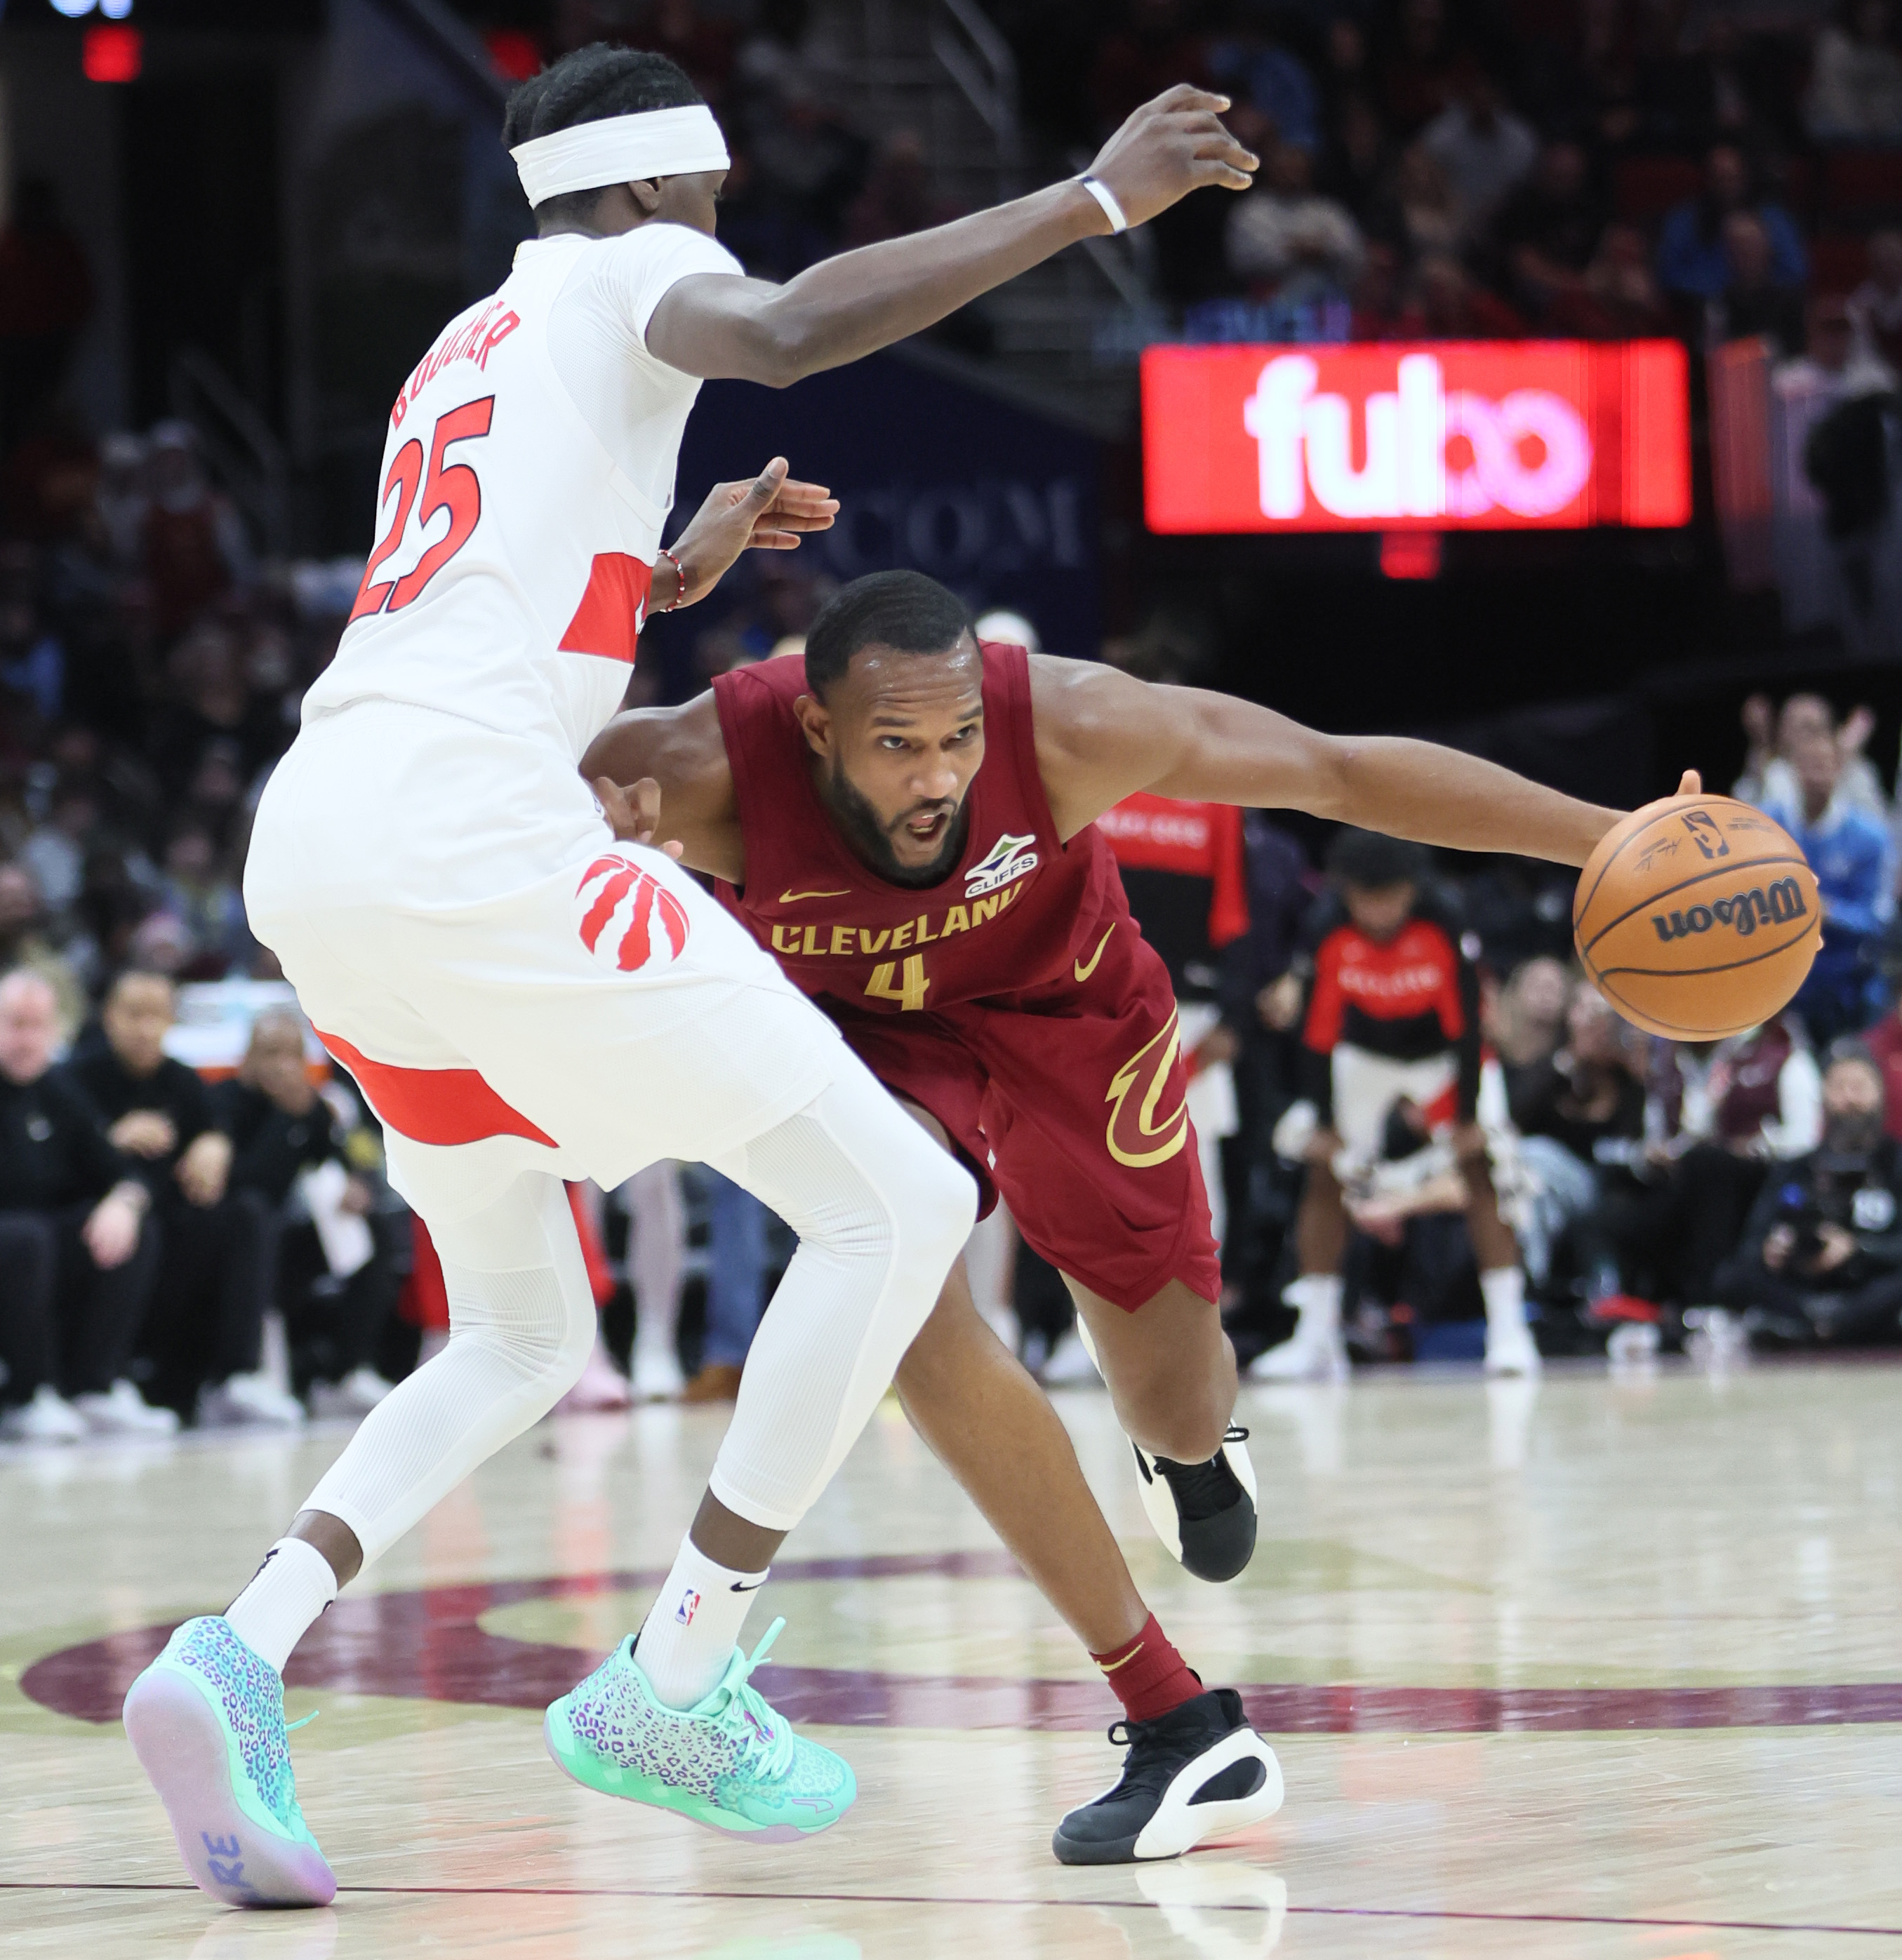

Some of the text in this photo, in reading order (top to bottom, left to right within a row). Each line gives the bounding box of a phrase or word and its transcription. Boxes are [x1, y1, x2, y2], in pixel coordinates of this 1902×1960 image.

[391, 300, 521, 430] BOUCHER
[1244, 354, 1592, 520] fubo
[347, 394, 496, 625] 25
[969, 858, 1034, 894] CLIFFS
[1651, 876, 1807, 942] Wilson
[864, 953, 930, 1011] 4
